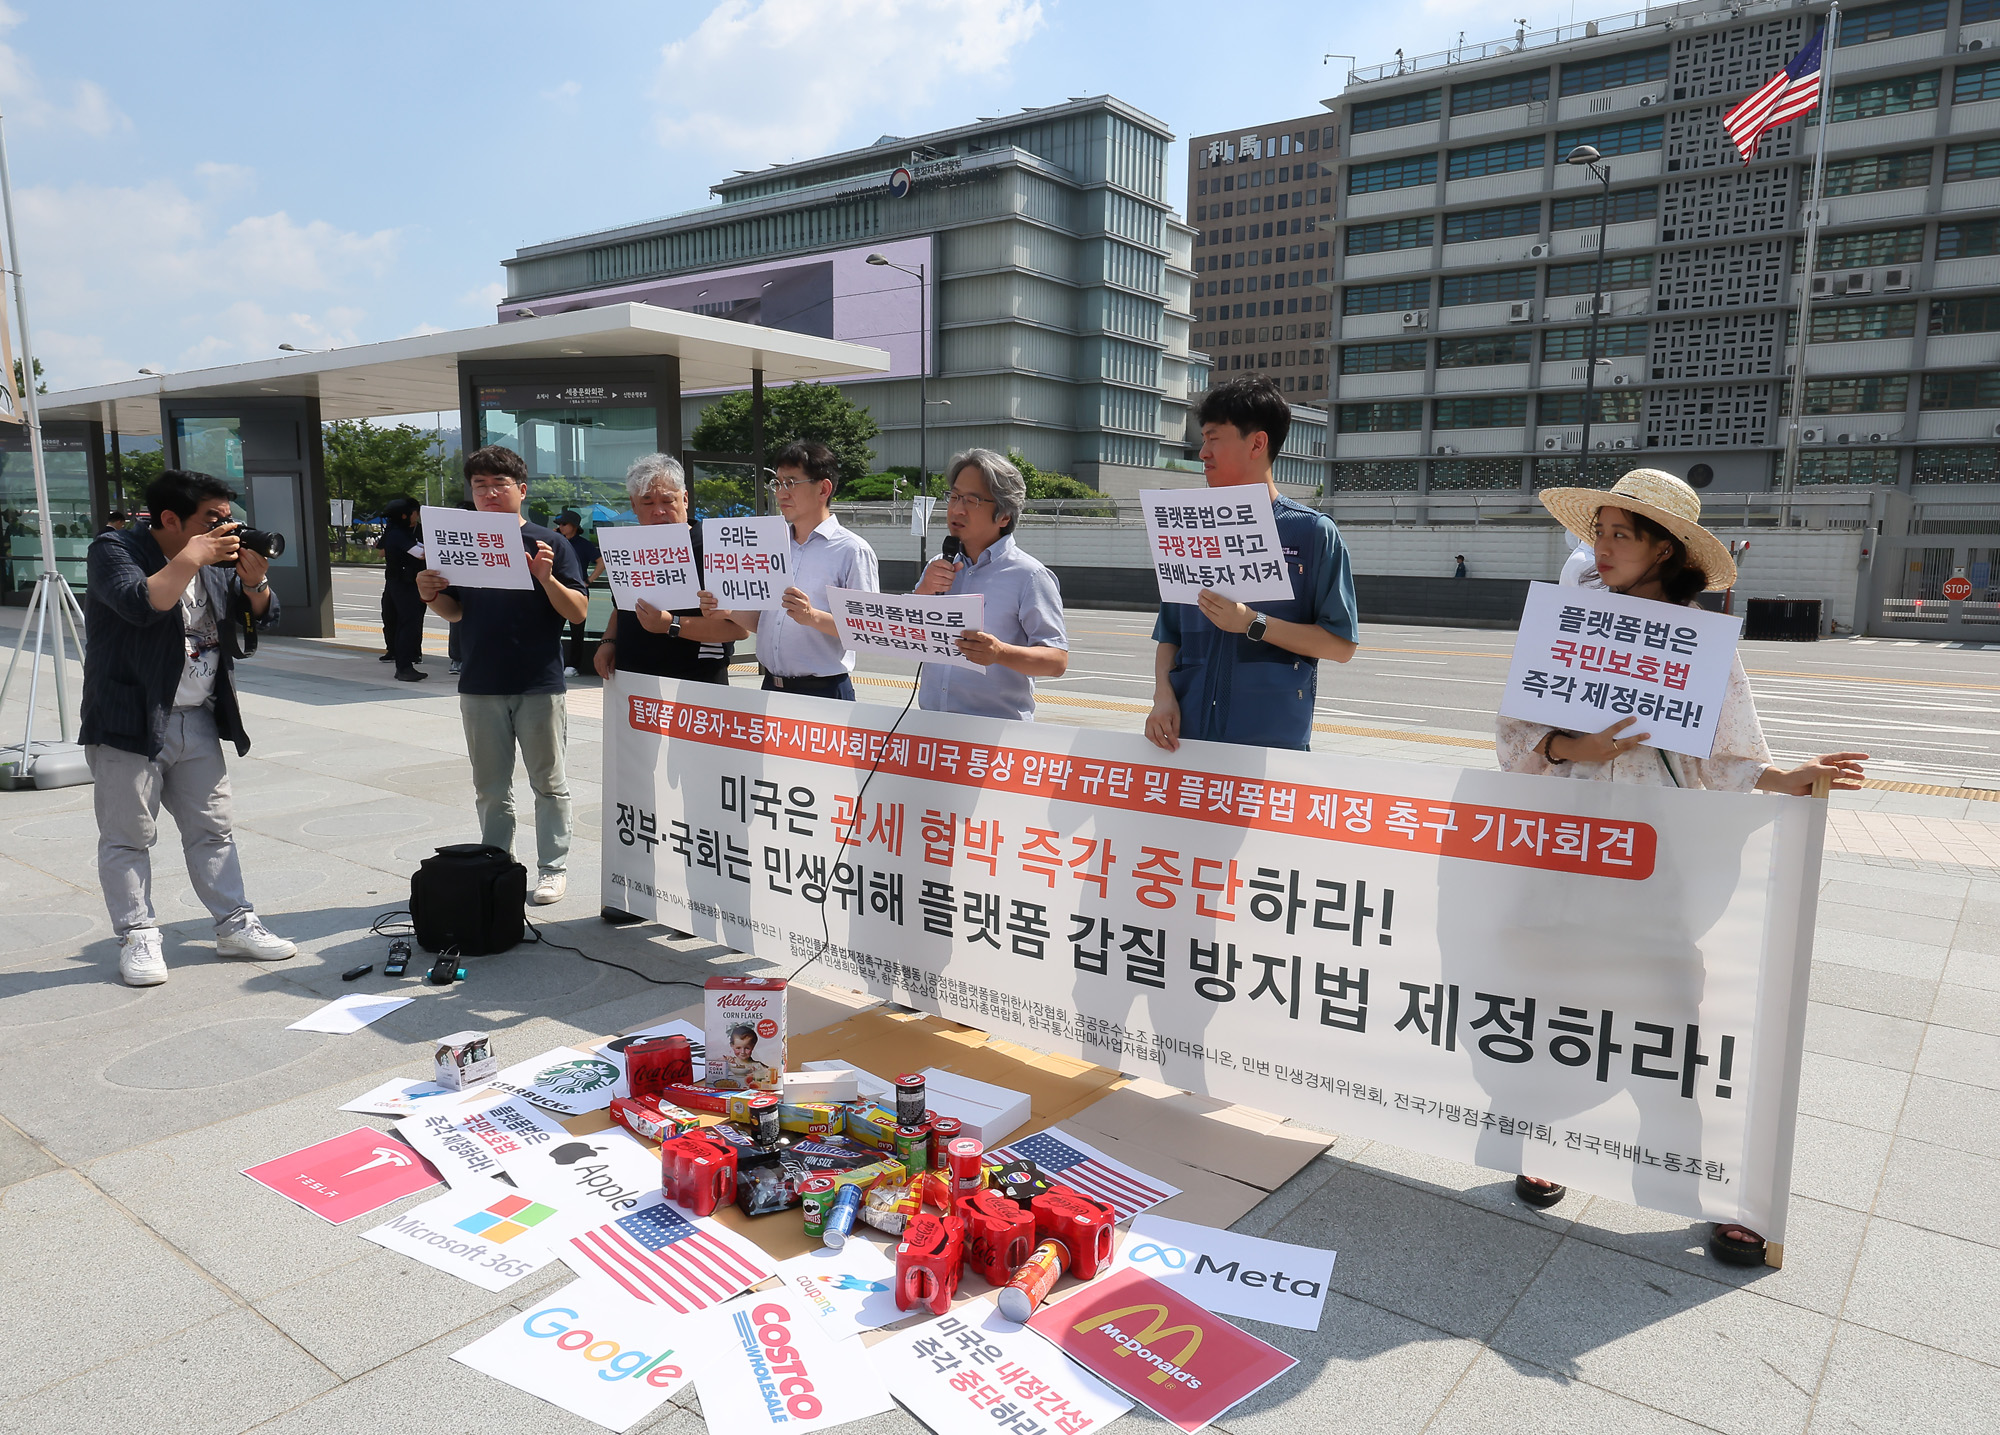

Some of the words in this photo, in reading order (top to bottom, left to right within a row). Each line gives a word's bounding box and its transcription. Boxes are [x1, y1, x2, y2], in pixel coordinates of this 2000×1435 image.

[1208, 133, 1258, 163] 利馬
[1154, 504, 1257, 529] 플랫폼법으로
[434, 529, 473, 547] 말로만
[476, 532, 504, 549] 동맹
[719, 526, 758, 547] 우리는
[1158, 534, 1185, 557] 쿠팡
[1187, 535, 1222, 559] 갑질
[1224, 533, 1268, 557] 막고
[437, 550, 479, 567] 실상은
[480, 551, 510, 568] 깡패
[603, 549, 631, 566] 미국은
[633, 546, 691, 565] 내정간섭
[704, 553, 738, 574] 미국의
[741, 552, 786, 574] 속국이
[612, 570, 628, 587] 즉각
[630, 567, 687, 588] 중단하라
[1158, 562, 1236, 588] 택배노동자
[1238, 559, 1283, 584] 지켜
[722, 579, 771, 601] 아니다!
[1944, 584, 1970, 594] STOP
[844, 600, 966, 628] 플랫폼법으로
[845, 617, 885, 634] 배민
[888, 623, 927, 642] 갑질
[852, 632, 928, 654] 자영업자
[1558, 605, 1698, 655] 플랫폼법은
[1550, 639, 1691, 691] 국민보호법
[1521, 669, 1577, 704] 즉각
[1580, 681, 1704, 729] 제정하라!
[632, 699, 674, 729] 플랫폼
[917, 743, 961, 775] 미국
[967, 748, 1015, 783] 통상
[1022, 755, 1073, 791] 압박
[1078, 763, 1134, 799] 규탄
[1143, 771, 1170, 805] 및
[1178, 774, 1296, 824] 플랫폼법
[1307, 793, 1374, 834] 제정
[1384, 800, 1458, 845] 촉구
[1472, 812, 1635, 867] 기자회견
[720, 775, 818, 836] 미국은
[830, 794, 904, 856] 관세
[920, 808, 1004, 877] 협박
[1018, 826, 1116, 899] 즉각
[1131, 845, 1395, 947] 중단하라!
[656, 887, 669, 903] 오전
[686, 898, 721, 920] 광화문광장
[721, 910, 736, 924] 미국
[737, 915, 760, 932] 대사관
[761, 923, 777, 938] 인근
[615, 802, 753, 884] 정부·국회는
[764, 845, 904, 926] 민생위해
[917, 878, 1051, 960] 플랫폼
[1067, 913, 1166, 989] 갑질
[1190, 937, 1370, 1034] 방지법
[1394, 980, 1736, 1099] 제정하라!
[717, 993, 768, 1011] Kellogg's
[722, 1011, 740, 1019] CORN
[487, 1080, 575, 1111] STARBUCKS
[671, 1082, 717, 1093] Colgate
[1074, 1013, 1149, 1045] 공공운수노조
[1152, 1033, 1236, 1070] 라이더유니온,
[1242, 1055, 1270, 1077] 민변
[1274, 1064, 1388, 1108] 민생경제위원회,
[1393, 1091, 1557, 1147] 전국가맹점주협의회,
[1564, 1130, 1731, 1185] 전국택배노동조합,
[425, 1115, 458, 1137] 즉각
[463, 1113, 522, 1155] 국민보호법
[441, 1133, 495, 1173] 제정하라!
[804, 1155, 817, 1166] FUN
[817, 1157, 835, 1167] SIZE
[878, 1142, 893, 1151] GLAD
[294, 1173, 340, 1199] TESLA
[574, 1163, 638, 1211] Apple
[383, 1214, 488, 1264] Microsoft
[480, 1252, 535, 1279] 365
[1194, 1253, 1321, 1299] Meta
[796, 1275, 837, 1317] coupang
[522, 1306, 684, 1388] Google
[752, 1302, 823, 1420] COSTCO
[912, 1336, 963, 1374] 즉각
[1099, 1322, 1203, 1391] McDonald's
[744, 1344, 789, 1424] WHOLESALE
[936, 1316, 1003, 1365] 미국은
[995, 1361, 1094, 1435] 내정간섭
